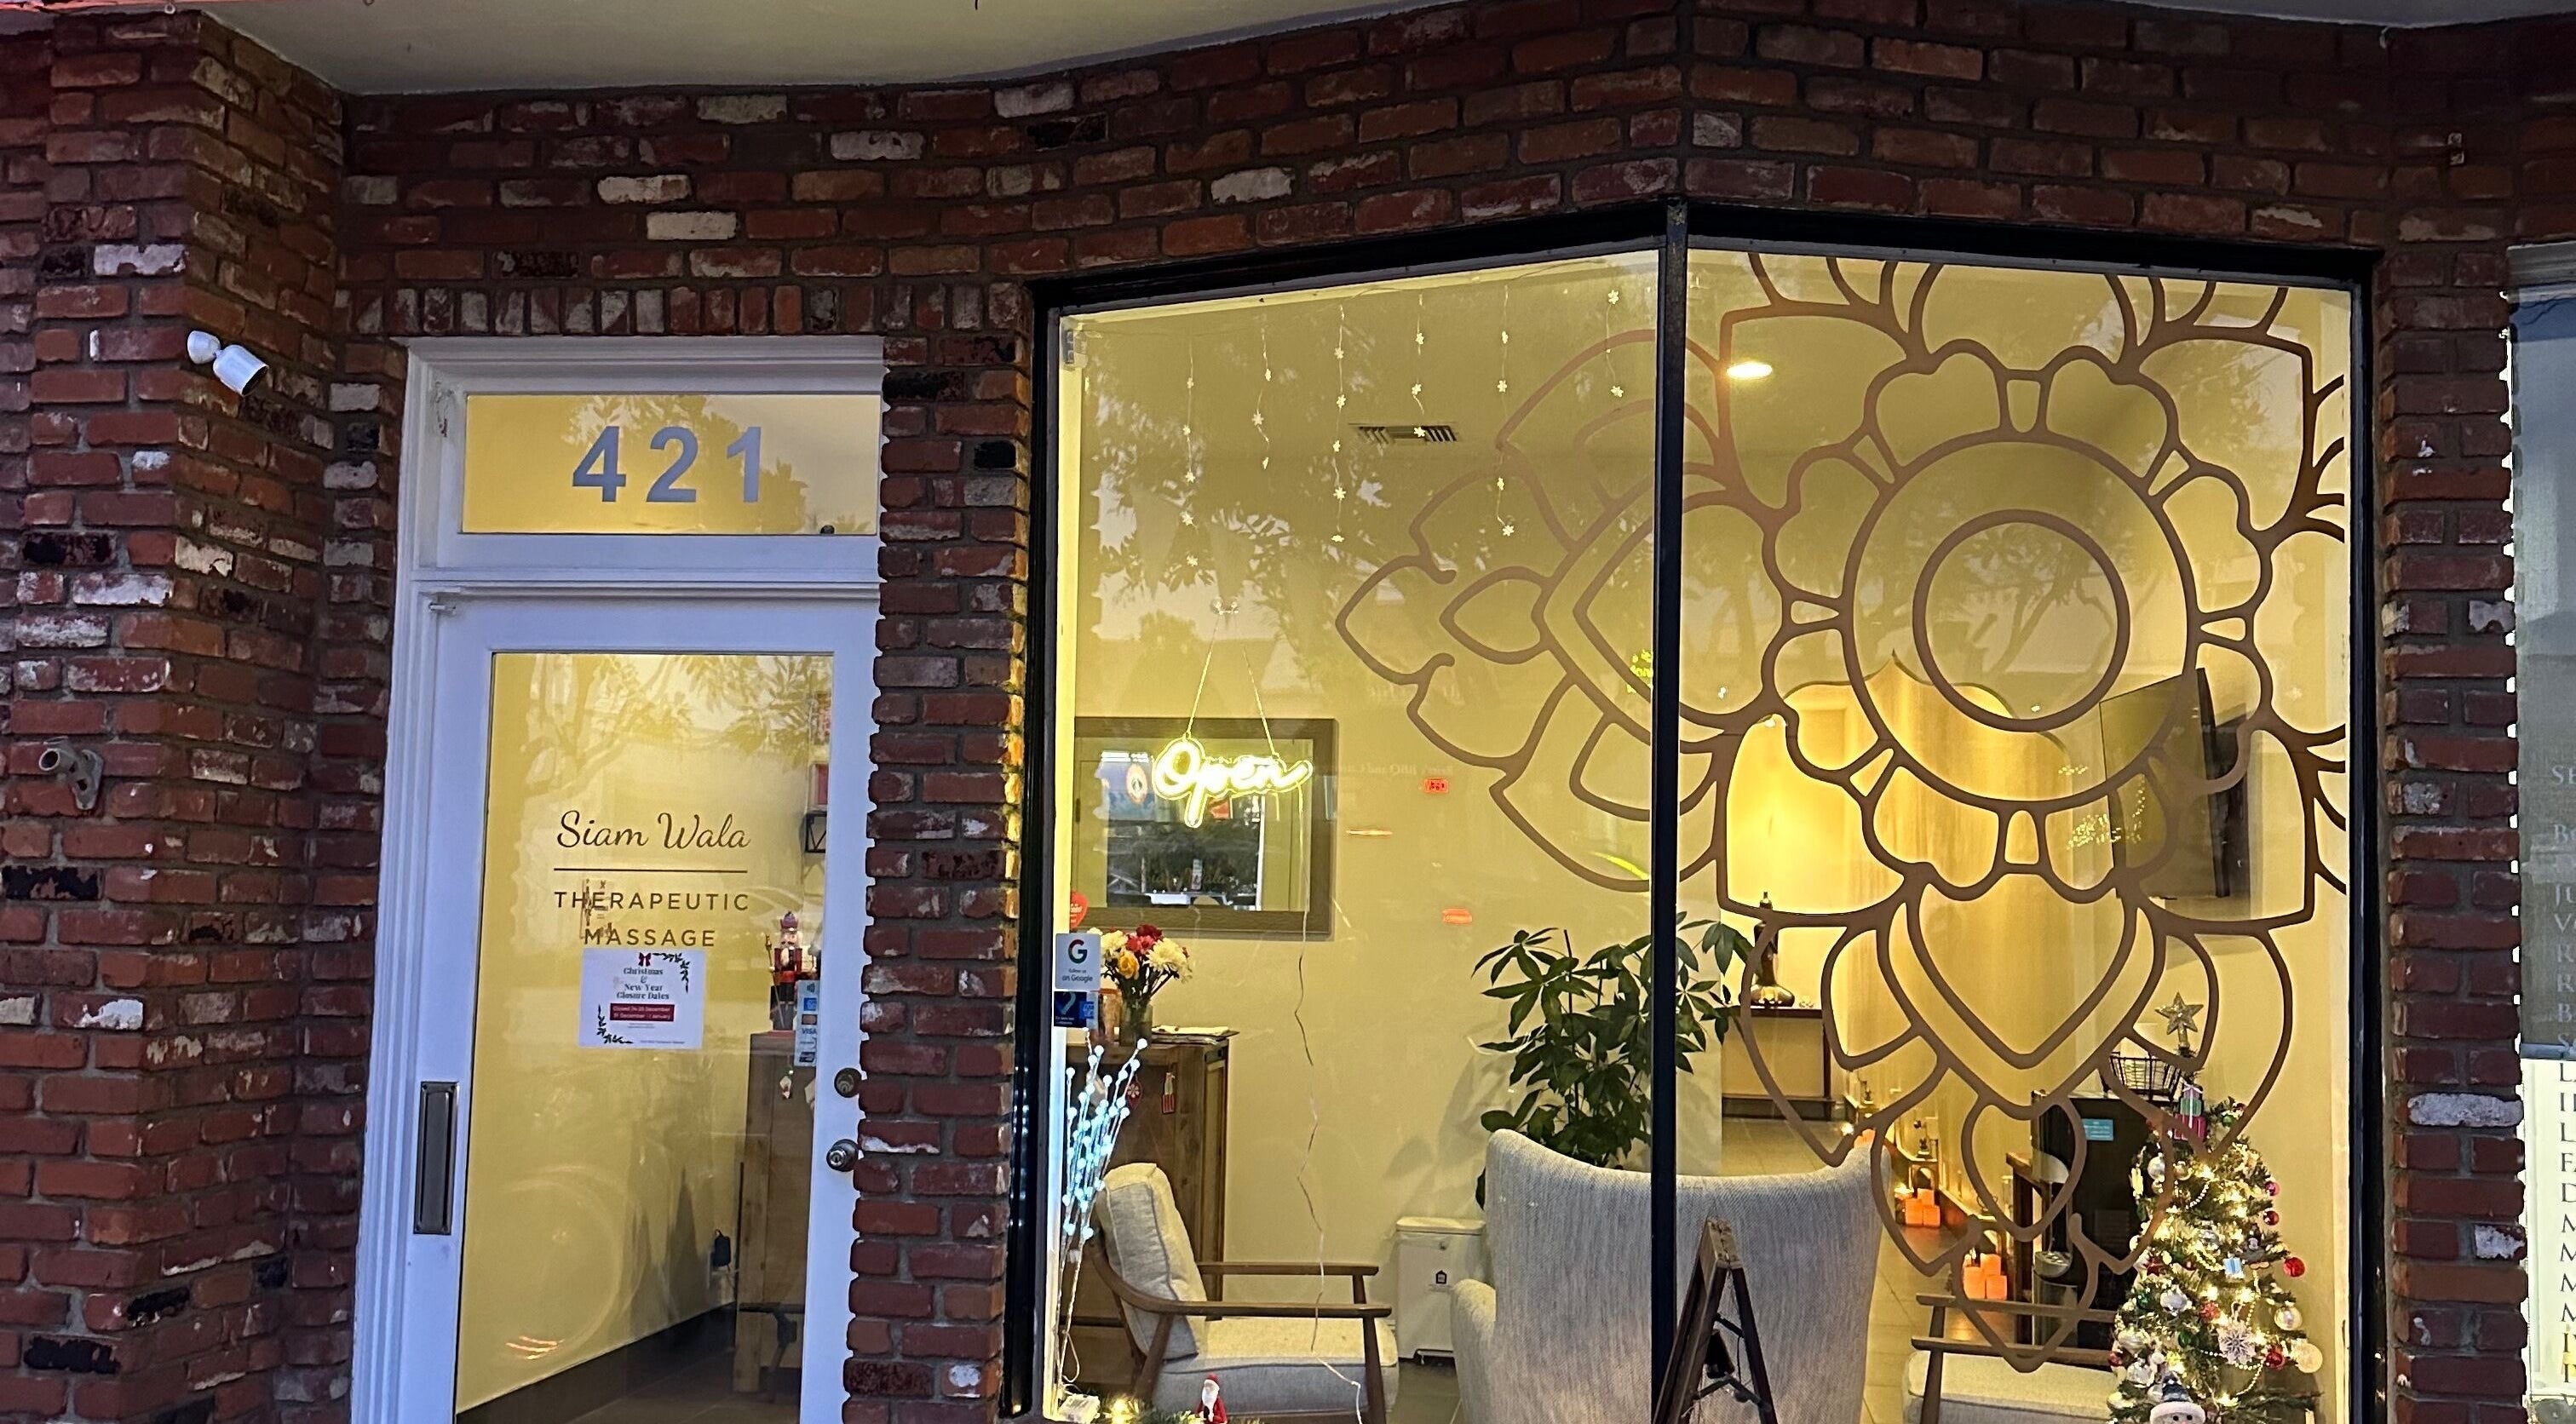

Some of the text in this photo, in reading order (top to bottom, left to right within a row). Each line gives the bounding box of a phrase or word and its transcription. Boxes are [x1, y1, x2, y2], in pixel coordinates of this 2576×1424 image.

[572, 425, 762, 502] 421
[1152, 737, 1313, 828] Open
[556, 809, 753, 849] Siam Wala
[554, 891, 750, 910] THERAPEUTIC
[584, 928, 716, 947] MASSAGE
[1071, 974, 1093, 984] Google
